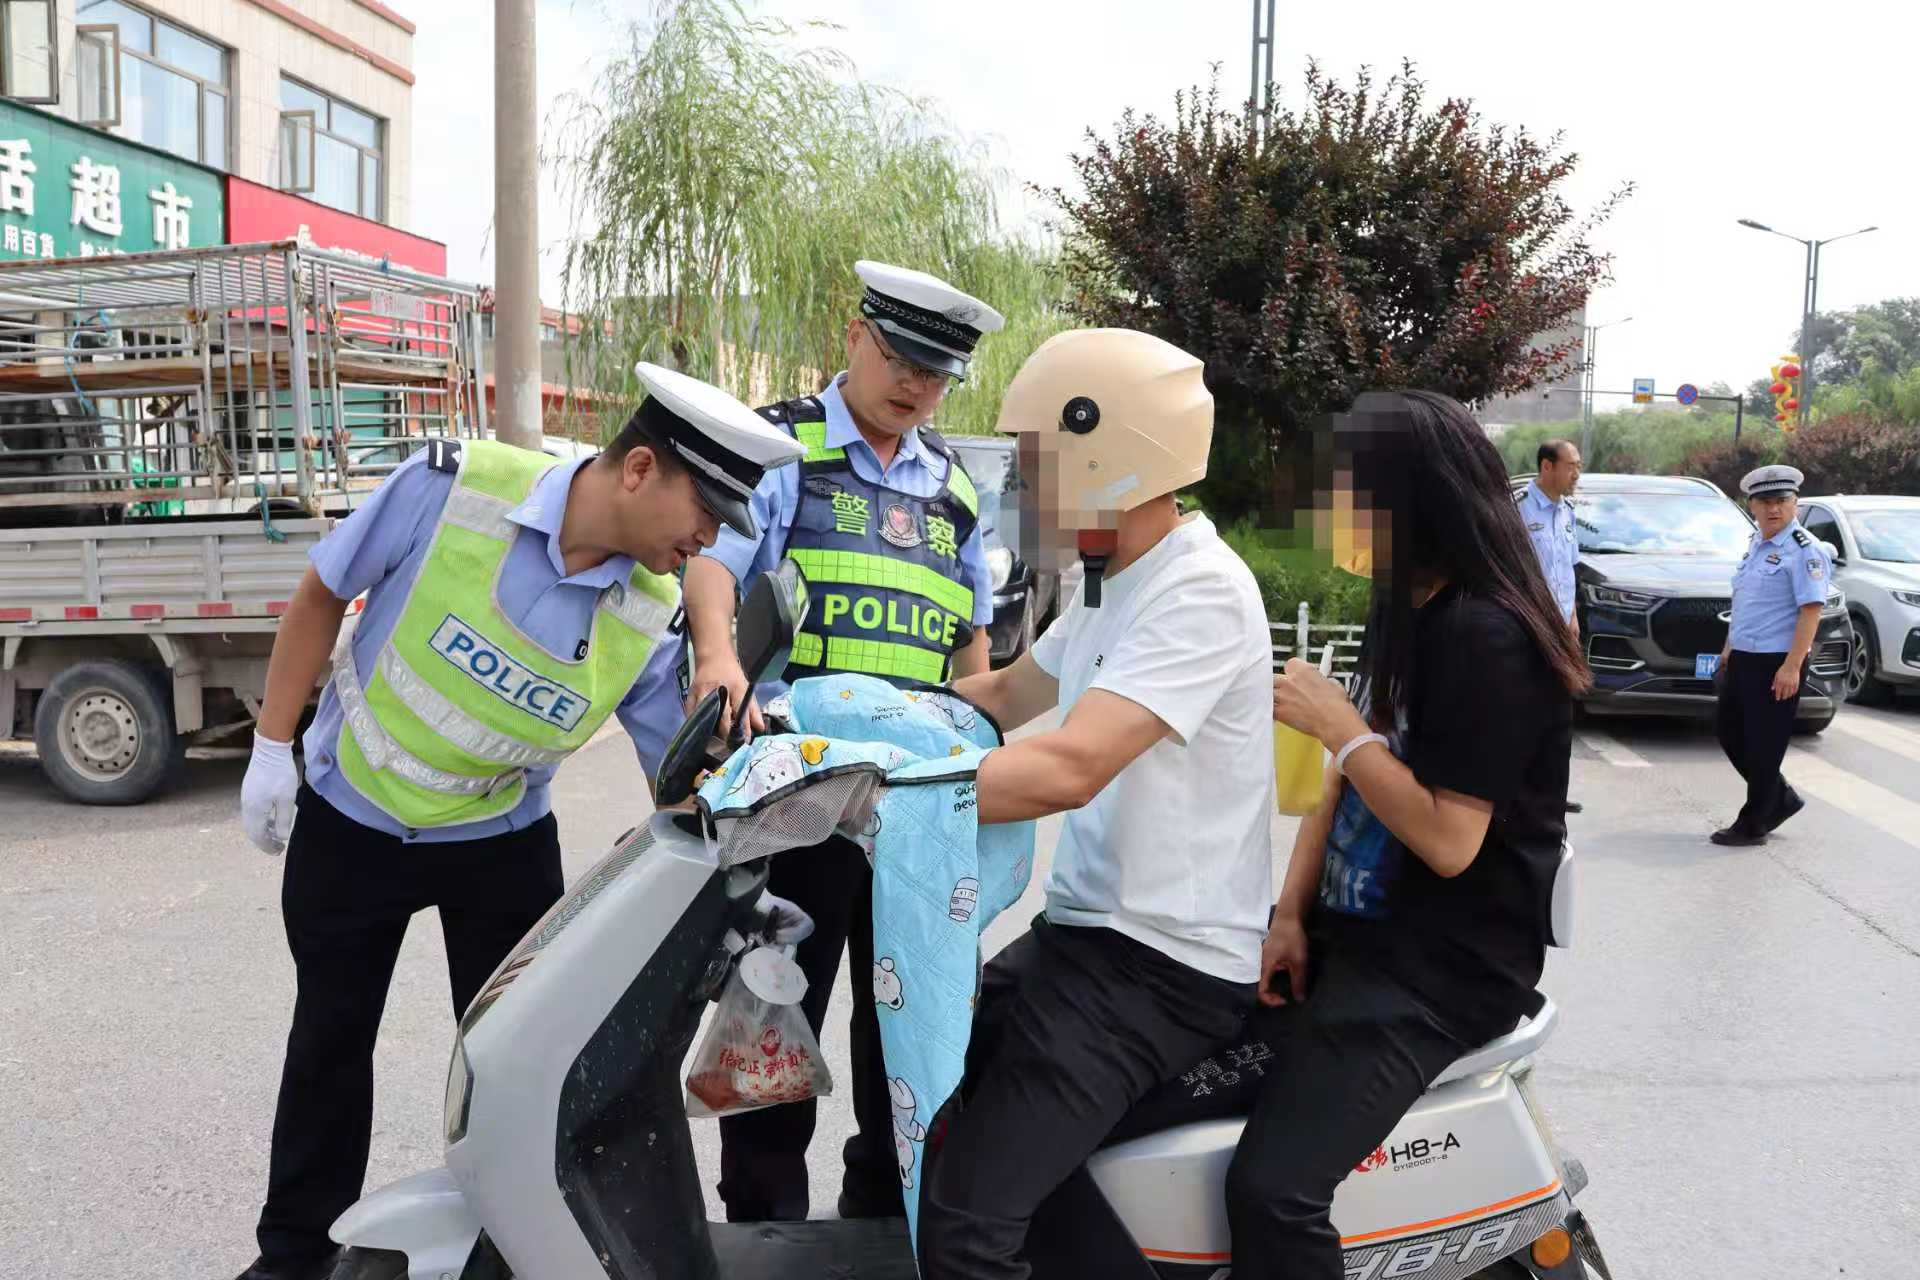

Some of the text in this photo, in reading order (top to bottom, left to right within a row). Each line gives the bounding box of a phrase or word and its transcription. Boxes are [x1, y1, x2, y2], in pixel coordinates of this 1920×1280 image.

[831, 490, 872, 537] 警
[925, 515, 959, 561] 察
[822, 593, 960, 648] POLICE
[445, 630, 576, 722] POLICE
[1390, 1131, 1461, 1164] H8-A
